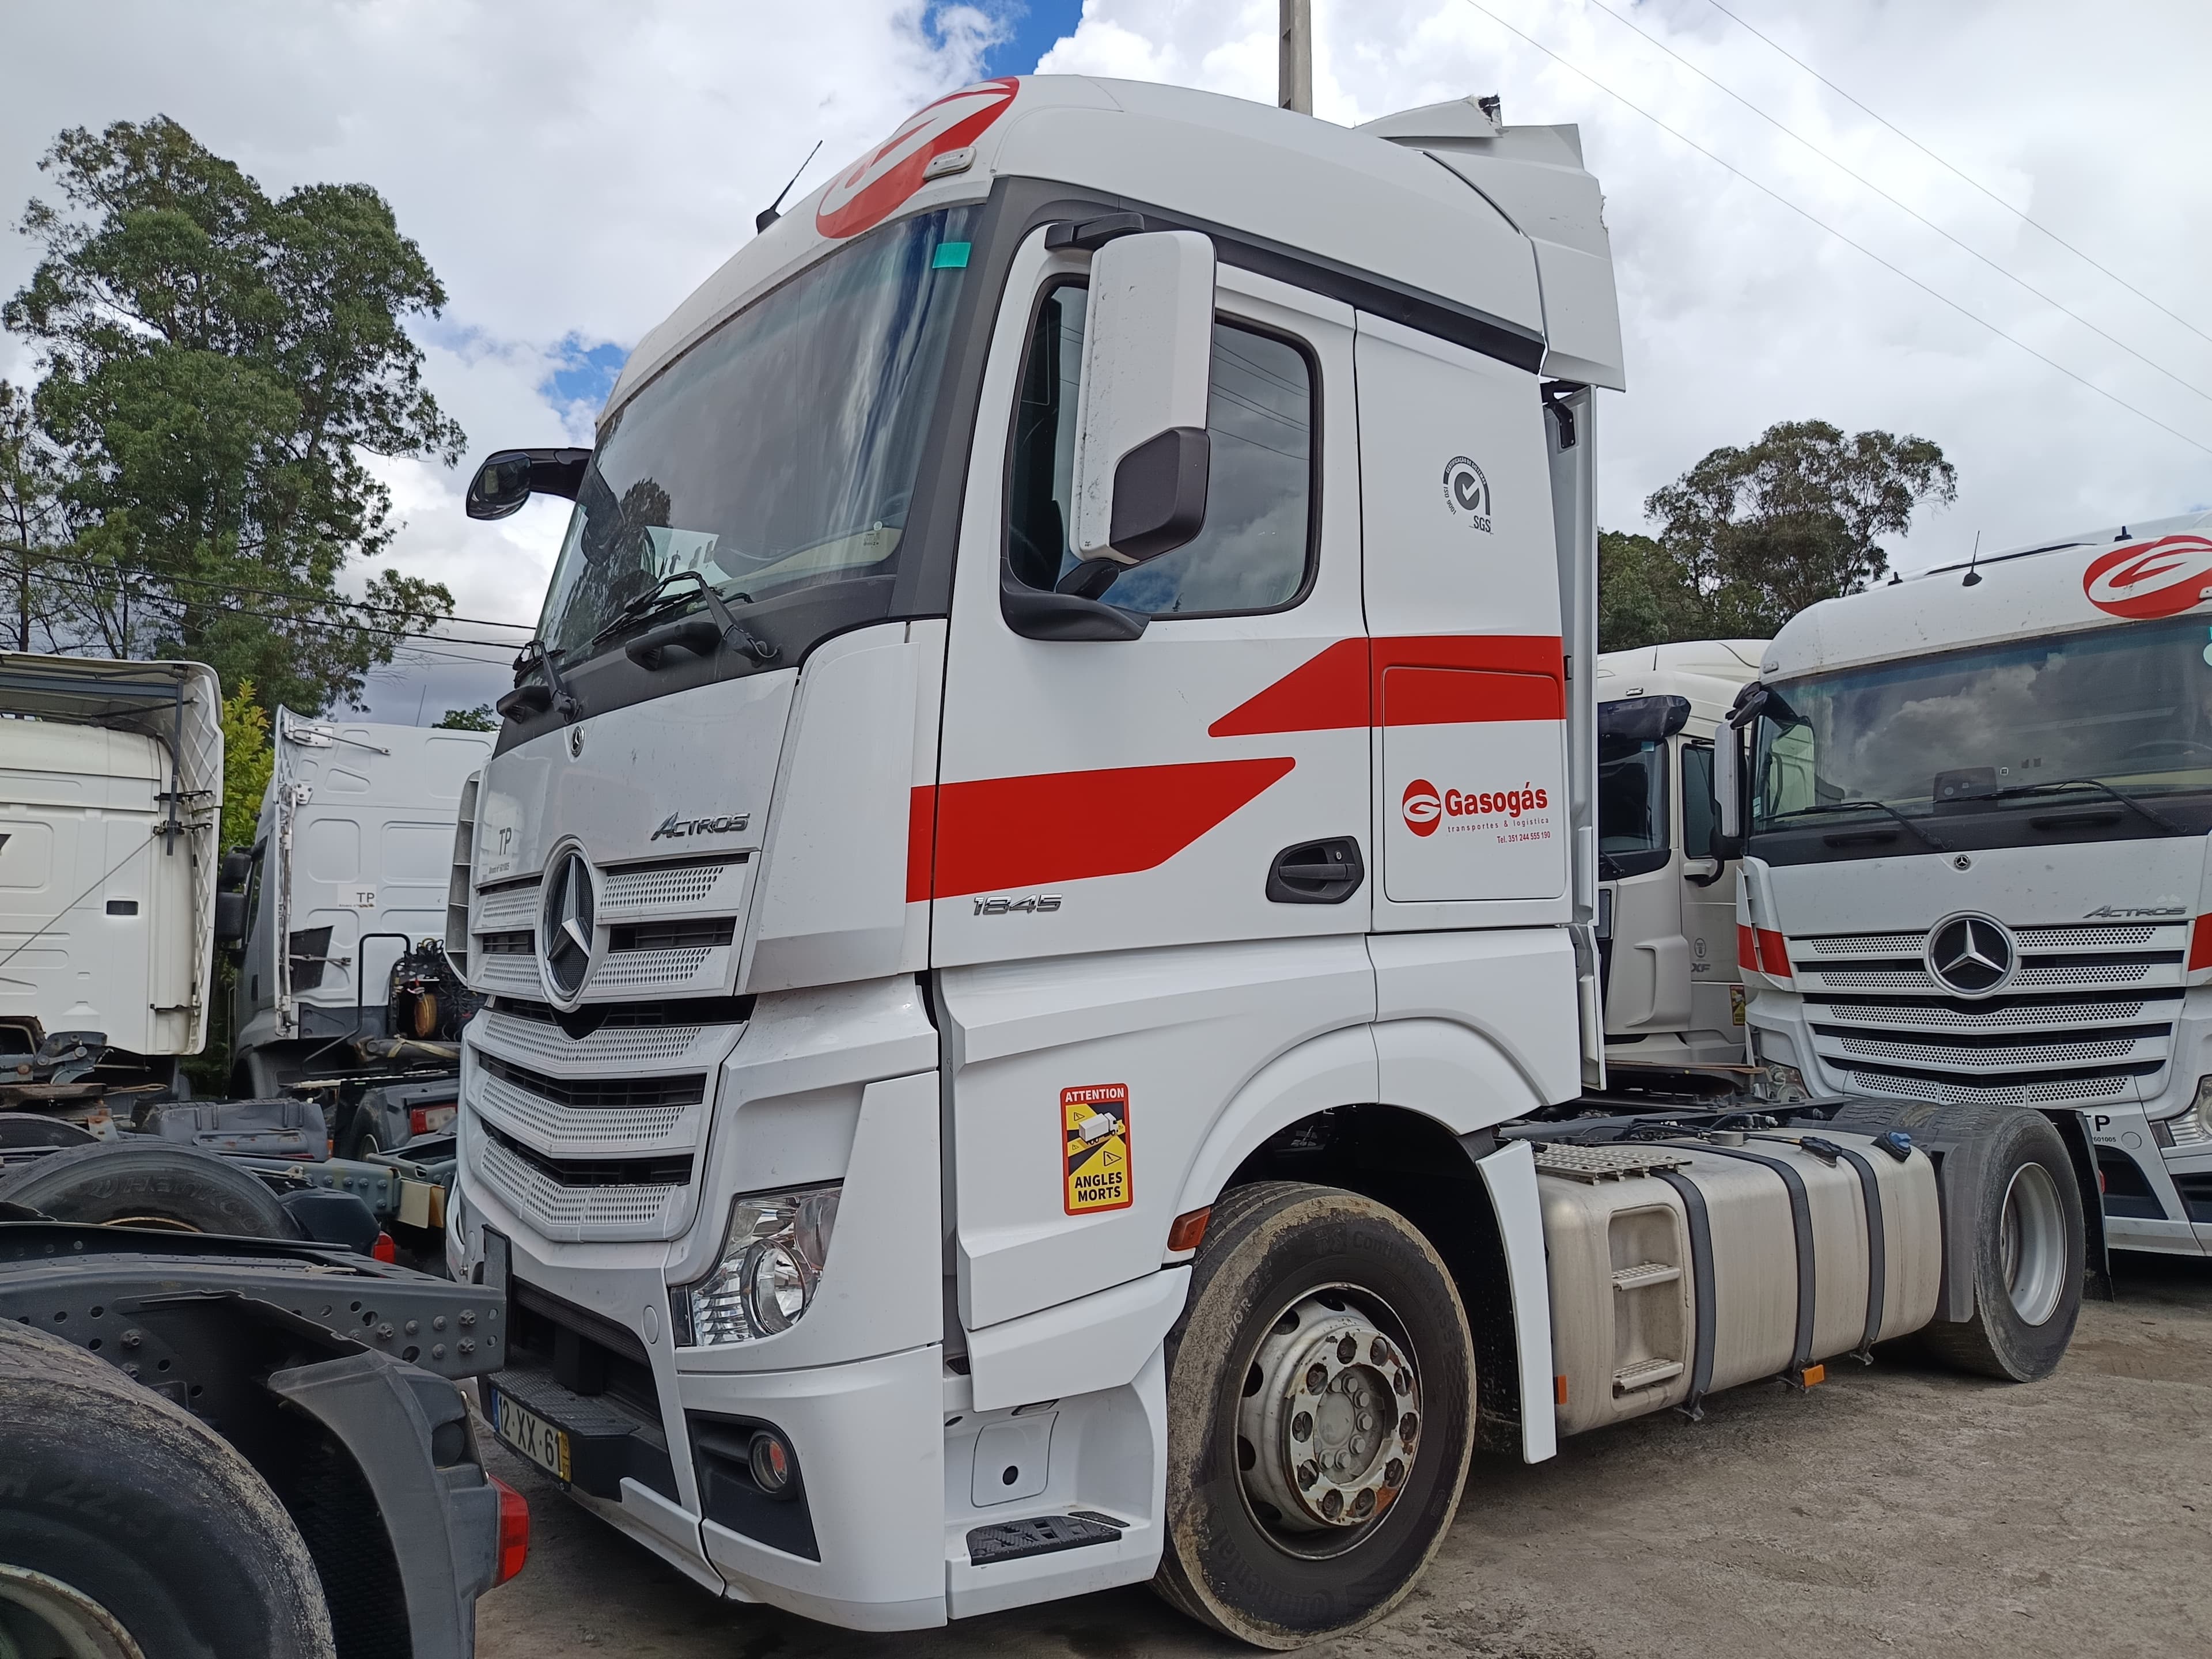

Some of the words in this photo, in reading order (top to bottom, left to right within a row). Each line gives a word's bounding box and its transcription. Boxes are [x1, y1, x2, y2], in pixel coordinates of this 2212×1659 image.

[1471, 462, 1487, 486] SISTEMAS
[1446, 499, 1457, 516] 9001
[1474, 515, 1491, 533] SGS
[1445, 782, 1548, 818] Gasogás
[1448, 823, 1499, 833] transportes
[499, 827, 512, 857] TP
[1497, 835, 1508, 843] Tel.
[1508, 834, 1518, 842] 351
[1518, 833, 1529, 841] 244
[1530, 832, 1540, 840] 555
[1541, 831, 1551, 839] 190
[356, 892, 375, 903] TP
[974, 893, 1062, 916] 1845
[1691, 963, 1711, 973] XF
[1065, 1087, 1124, 1103] ATTENTION
[1074, 1171, 1123, 1188] ANGLES
[1078, 1185, 1122, 1203] MORTS
